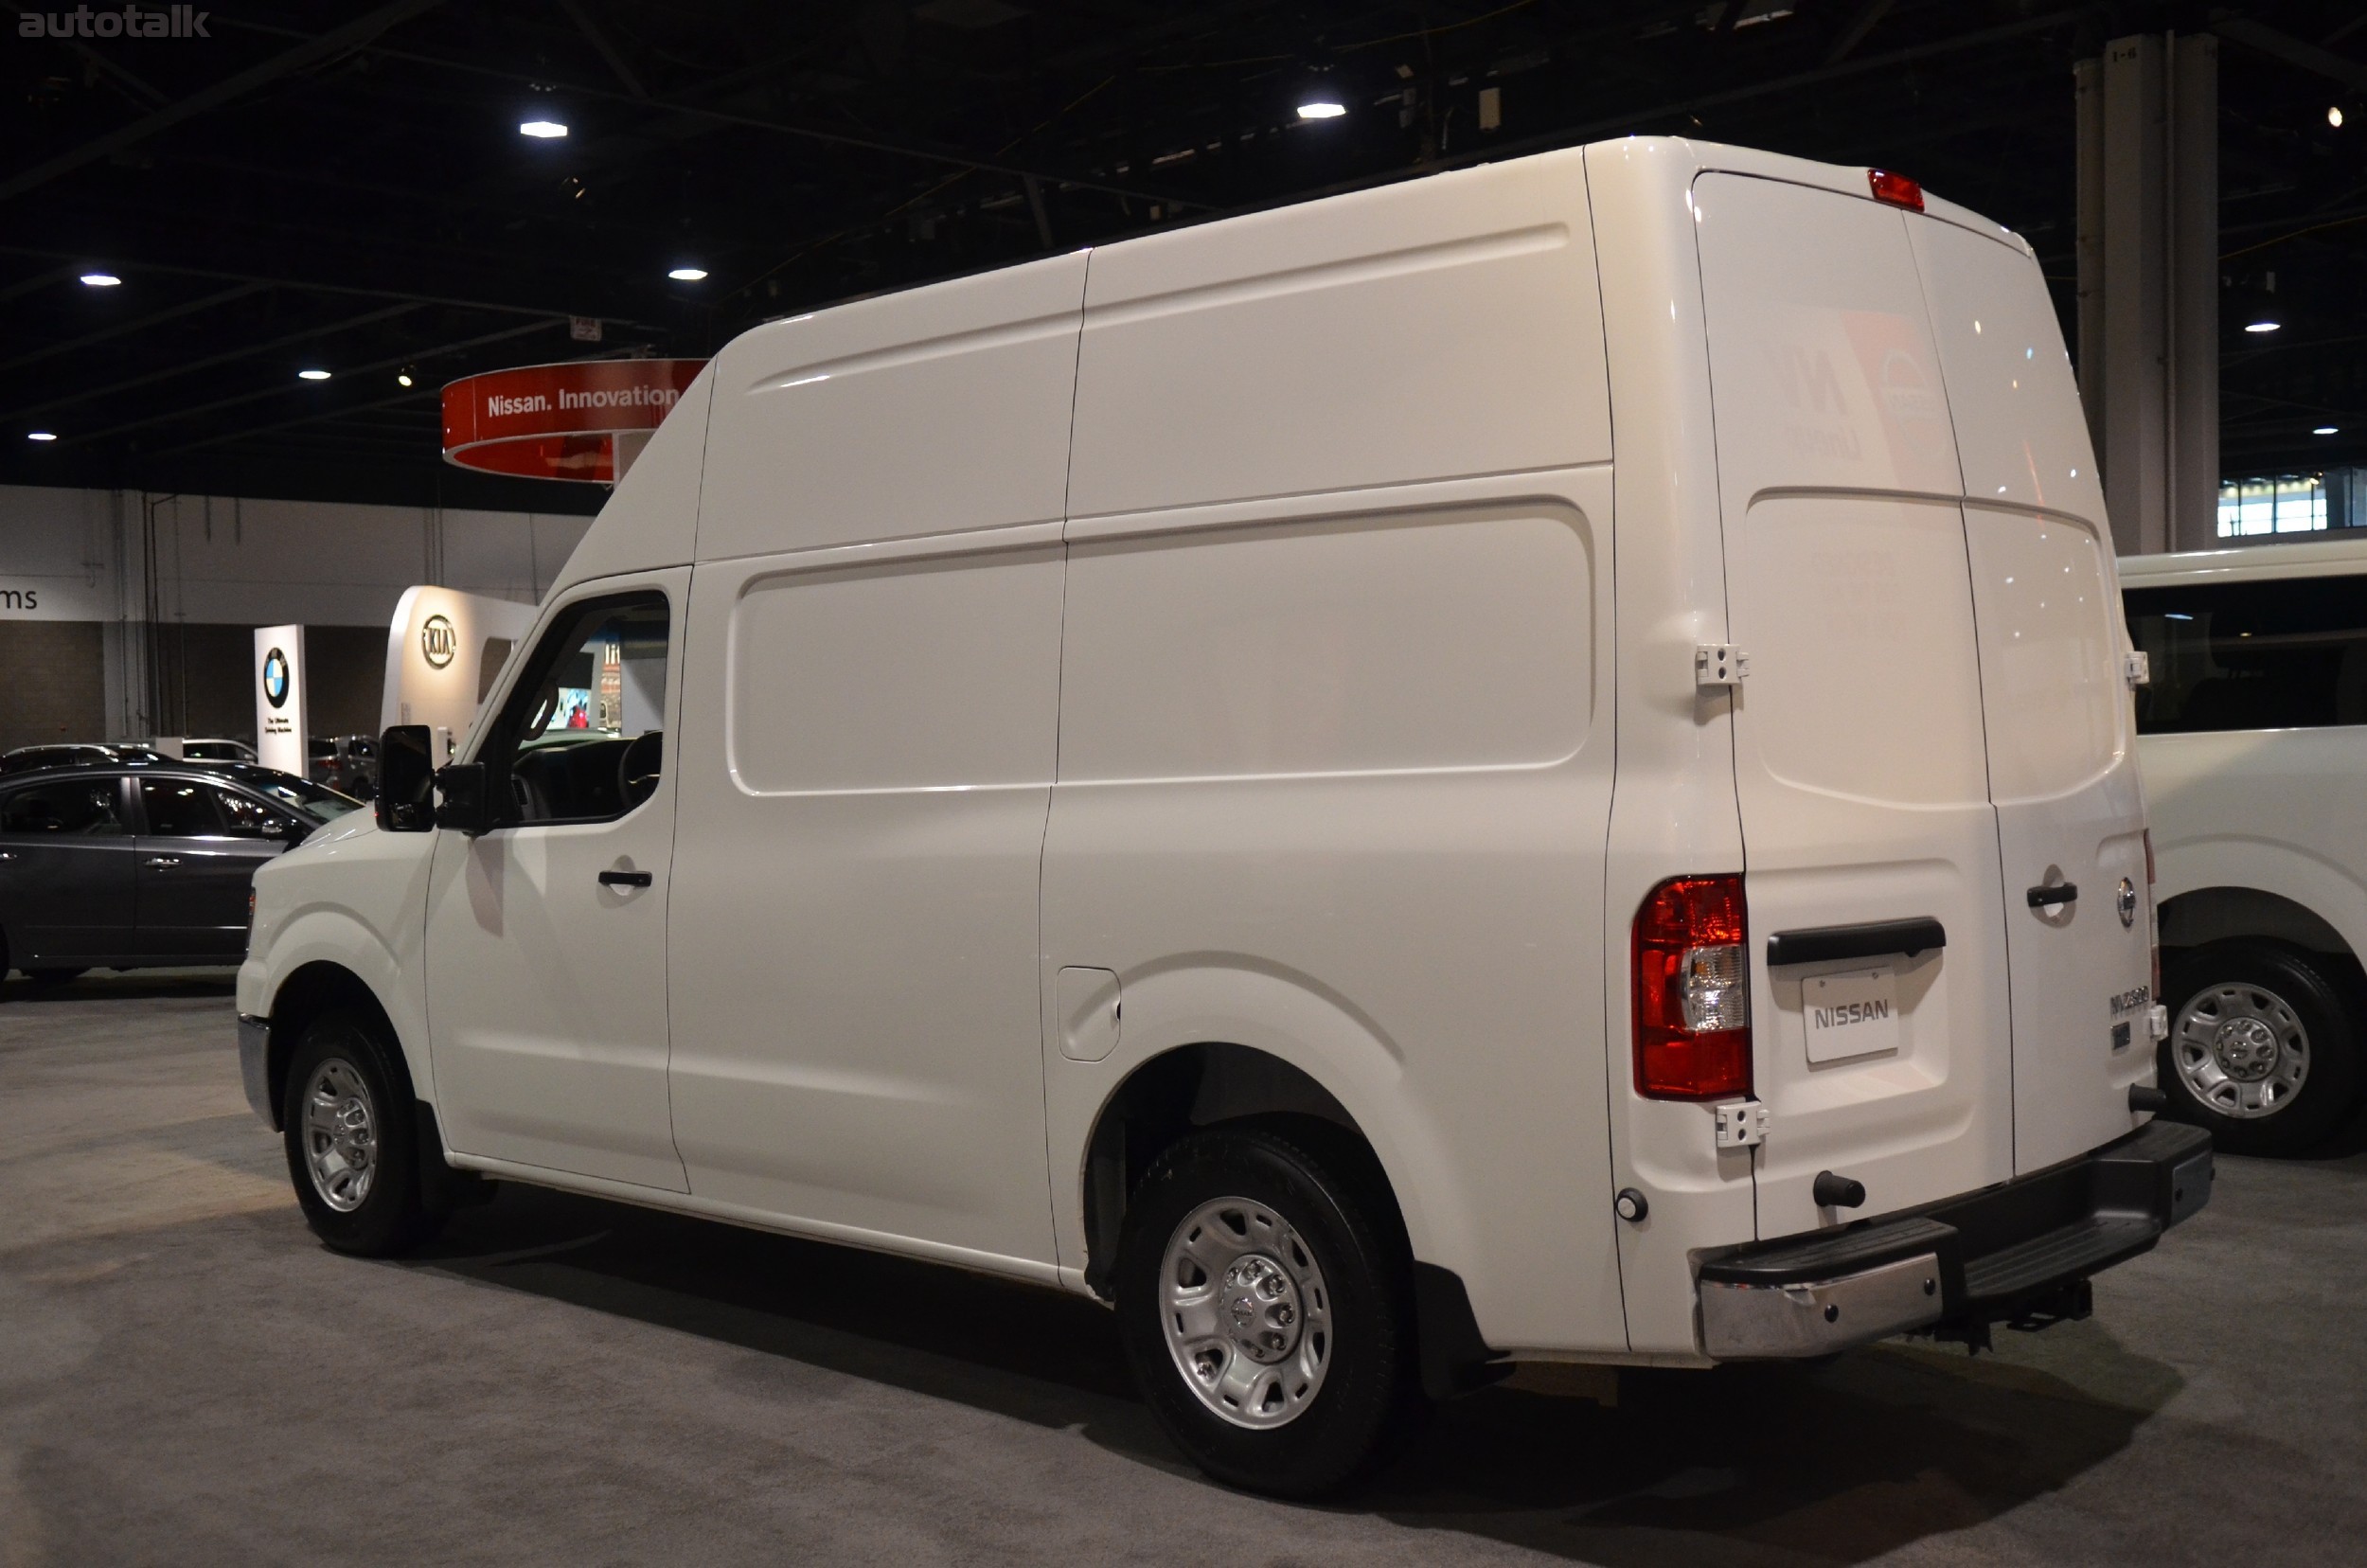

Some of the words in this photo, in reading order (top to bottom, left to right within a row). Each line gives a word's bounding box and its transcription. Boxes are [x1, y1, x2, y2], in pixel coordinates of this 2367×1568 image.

[488, 395, 552, 418] Nissan.
[559, 384, 680, 410] Innovation
[427, 627, 451, 655] KIA
[1815, 999, 1888, 1030] NISSAN
